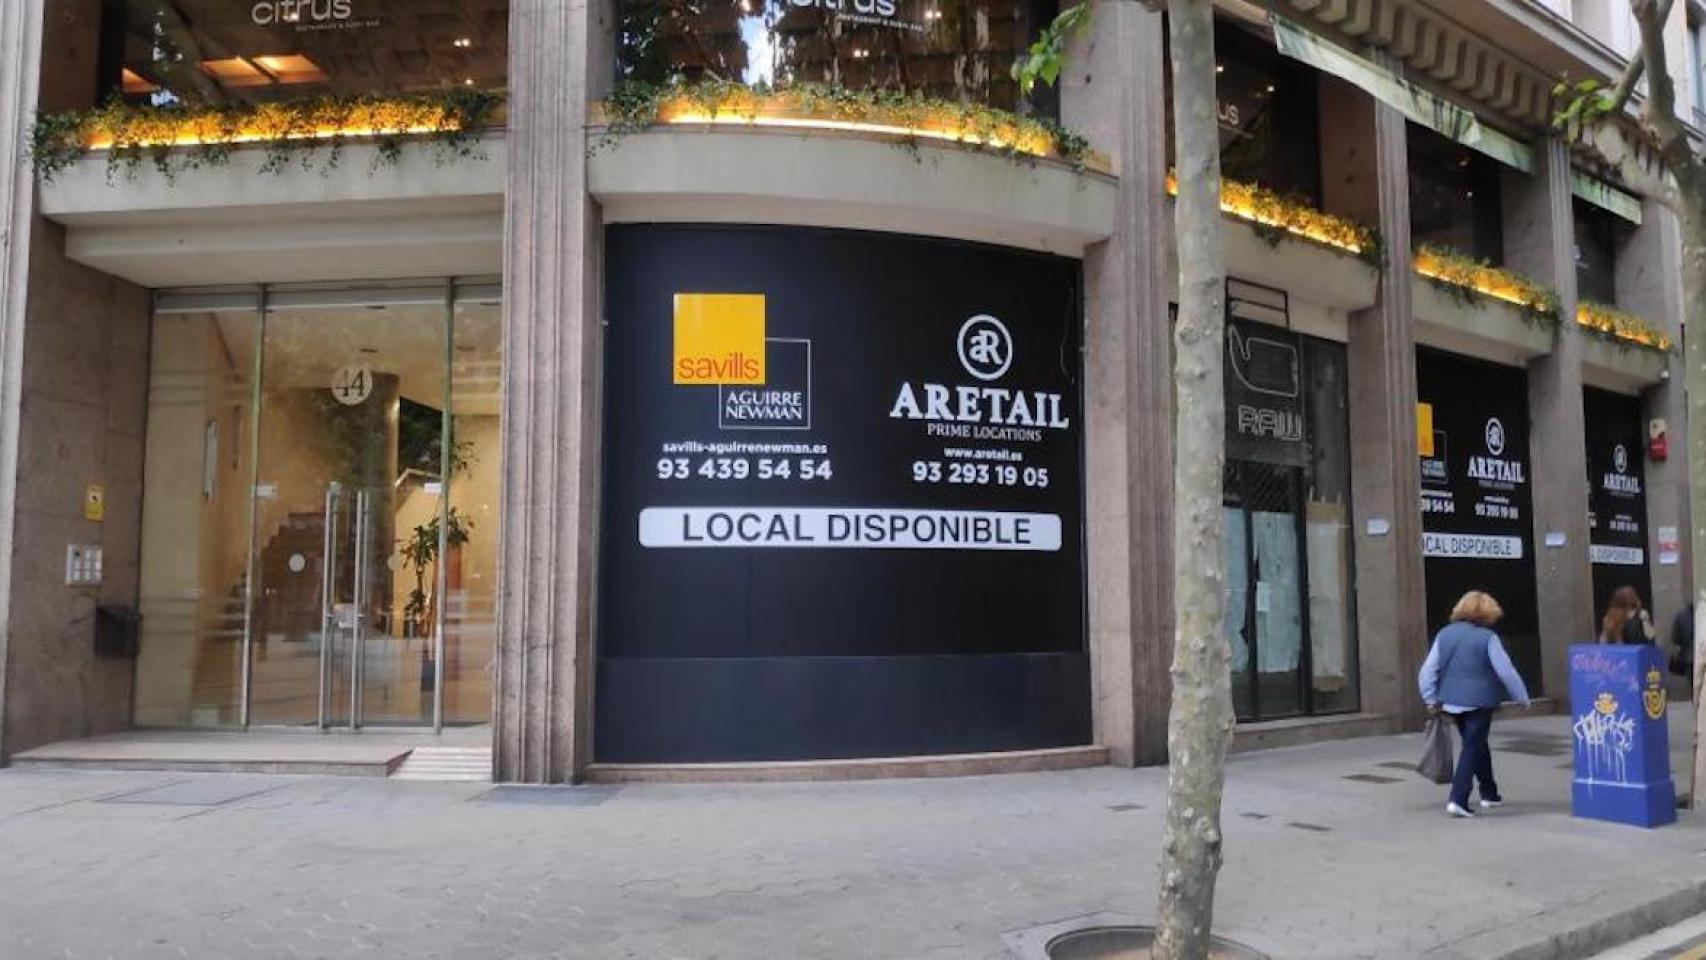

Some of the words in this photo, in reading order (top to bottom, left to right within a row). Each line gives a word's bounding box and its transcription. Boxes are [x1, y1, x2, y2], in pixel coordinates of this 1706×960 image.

[252, 0, 352, 24] citrus
[678, 352, 760, 380] savills
[726, 390, 803, 406] AGUIRRE
[889, 381, 1070, 429] ARETAIL
[725, 405, 803, 420] NEWMAN
[927, 422, 971, 438] PRIME
[973, 426, 1042, 442] LOCATIONS
[662, 441, 829, 455] savills-aguirrenewman.es
[943, 447, 1024, 462] www.aretail.es
[656, 458, 691, 480] 93
[697, 458, 750, 480] 439
[758, 459, 791, 480] 54
[799, 459, 833, 480] 54
[912, 461, 943, 483] 93
[948, 463, 990, 485] 293
[995, 466, 1019, 486] 19
[1022, 467, 1050, 488] 05
[1467, 455, 1526, 483] ARETAIL
[682, 513, 814, 542] LOCAL
[827, 514, 1032, 544] DISPONIBLE
[1422, 535, 1448, 554] CAL
